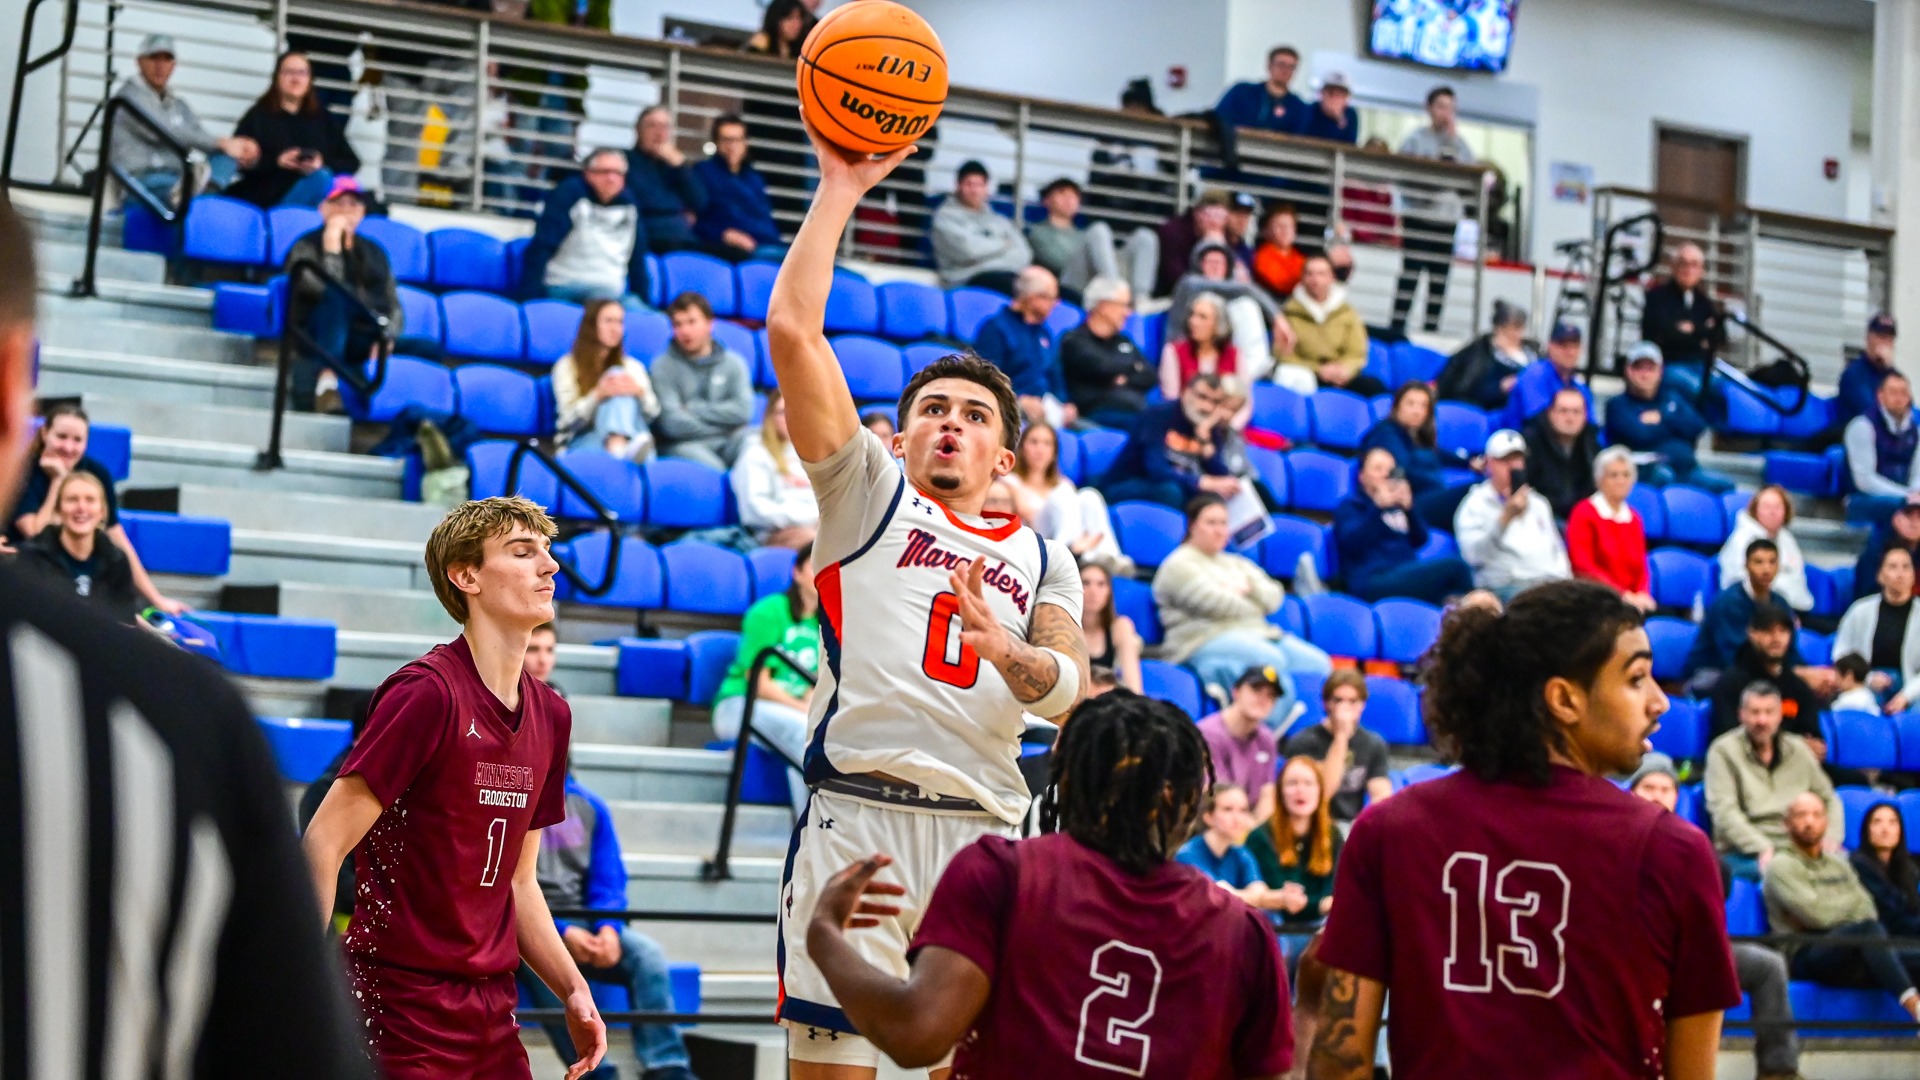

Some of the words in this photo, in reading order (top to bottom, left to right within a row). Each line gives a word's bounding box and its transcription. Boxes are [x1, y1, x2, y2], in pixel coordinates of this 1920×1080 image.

[840, 90, 929, 136] Wilson
[896, 528, 1029, 615] Marders
[922, 591, 980, 689] 0
[474, 762, 533, 790] MINNESOTA
[479, 789, 528, 808] CROOKSTON
[480, 818, 507, 886] 1
[1442, 851, 1571, 998] 13
[1075, 939, 1163, 1078] 2
